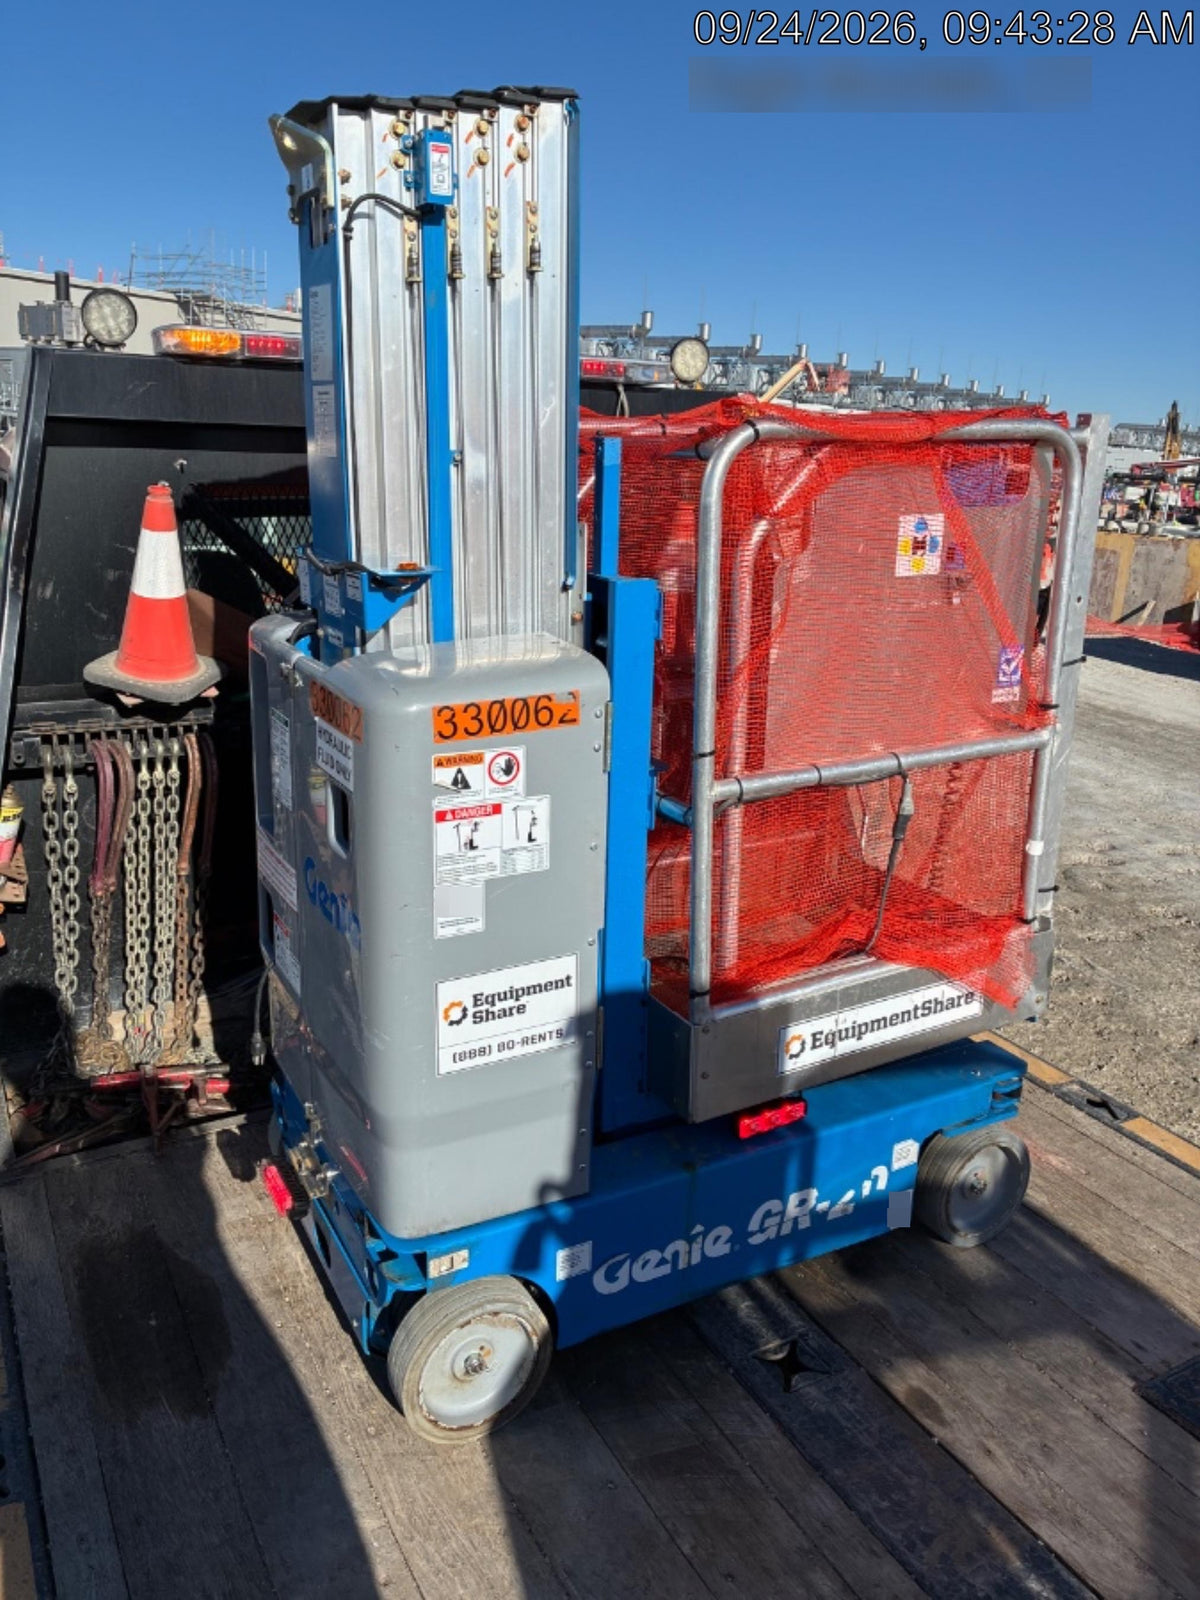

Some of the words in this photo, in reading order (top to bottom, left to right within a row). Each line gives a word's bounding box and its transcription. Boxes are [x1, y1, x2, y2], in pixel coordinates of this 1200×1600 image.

[436, 690, 578, 740] 330062
[445, 753, 483, 766] WARNING
[454, 804, 494, 819] DANGER
[471, 973, 573, 1009] Equipment
[471, 1002, 527, 1025] Share
[810, 991, 975, 1051] EquipmentShare
[497, 1028, 564, 1053] 80-RENTS
[592, 1224, 735, 1295] Genie
